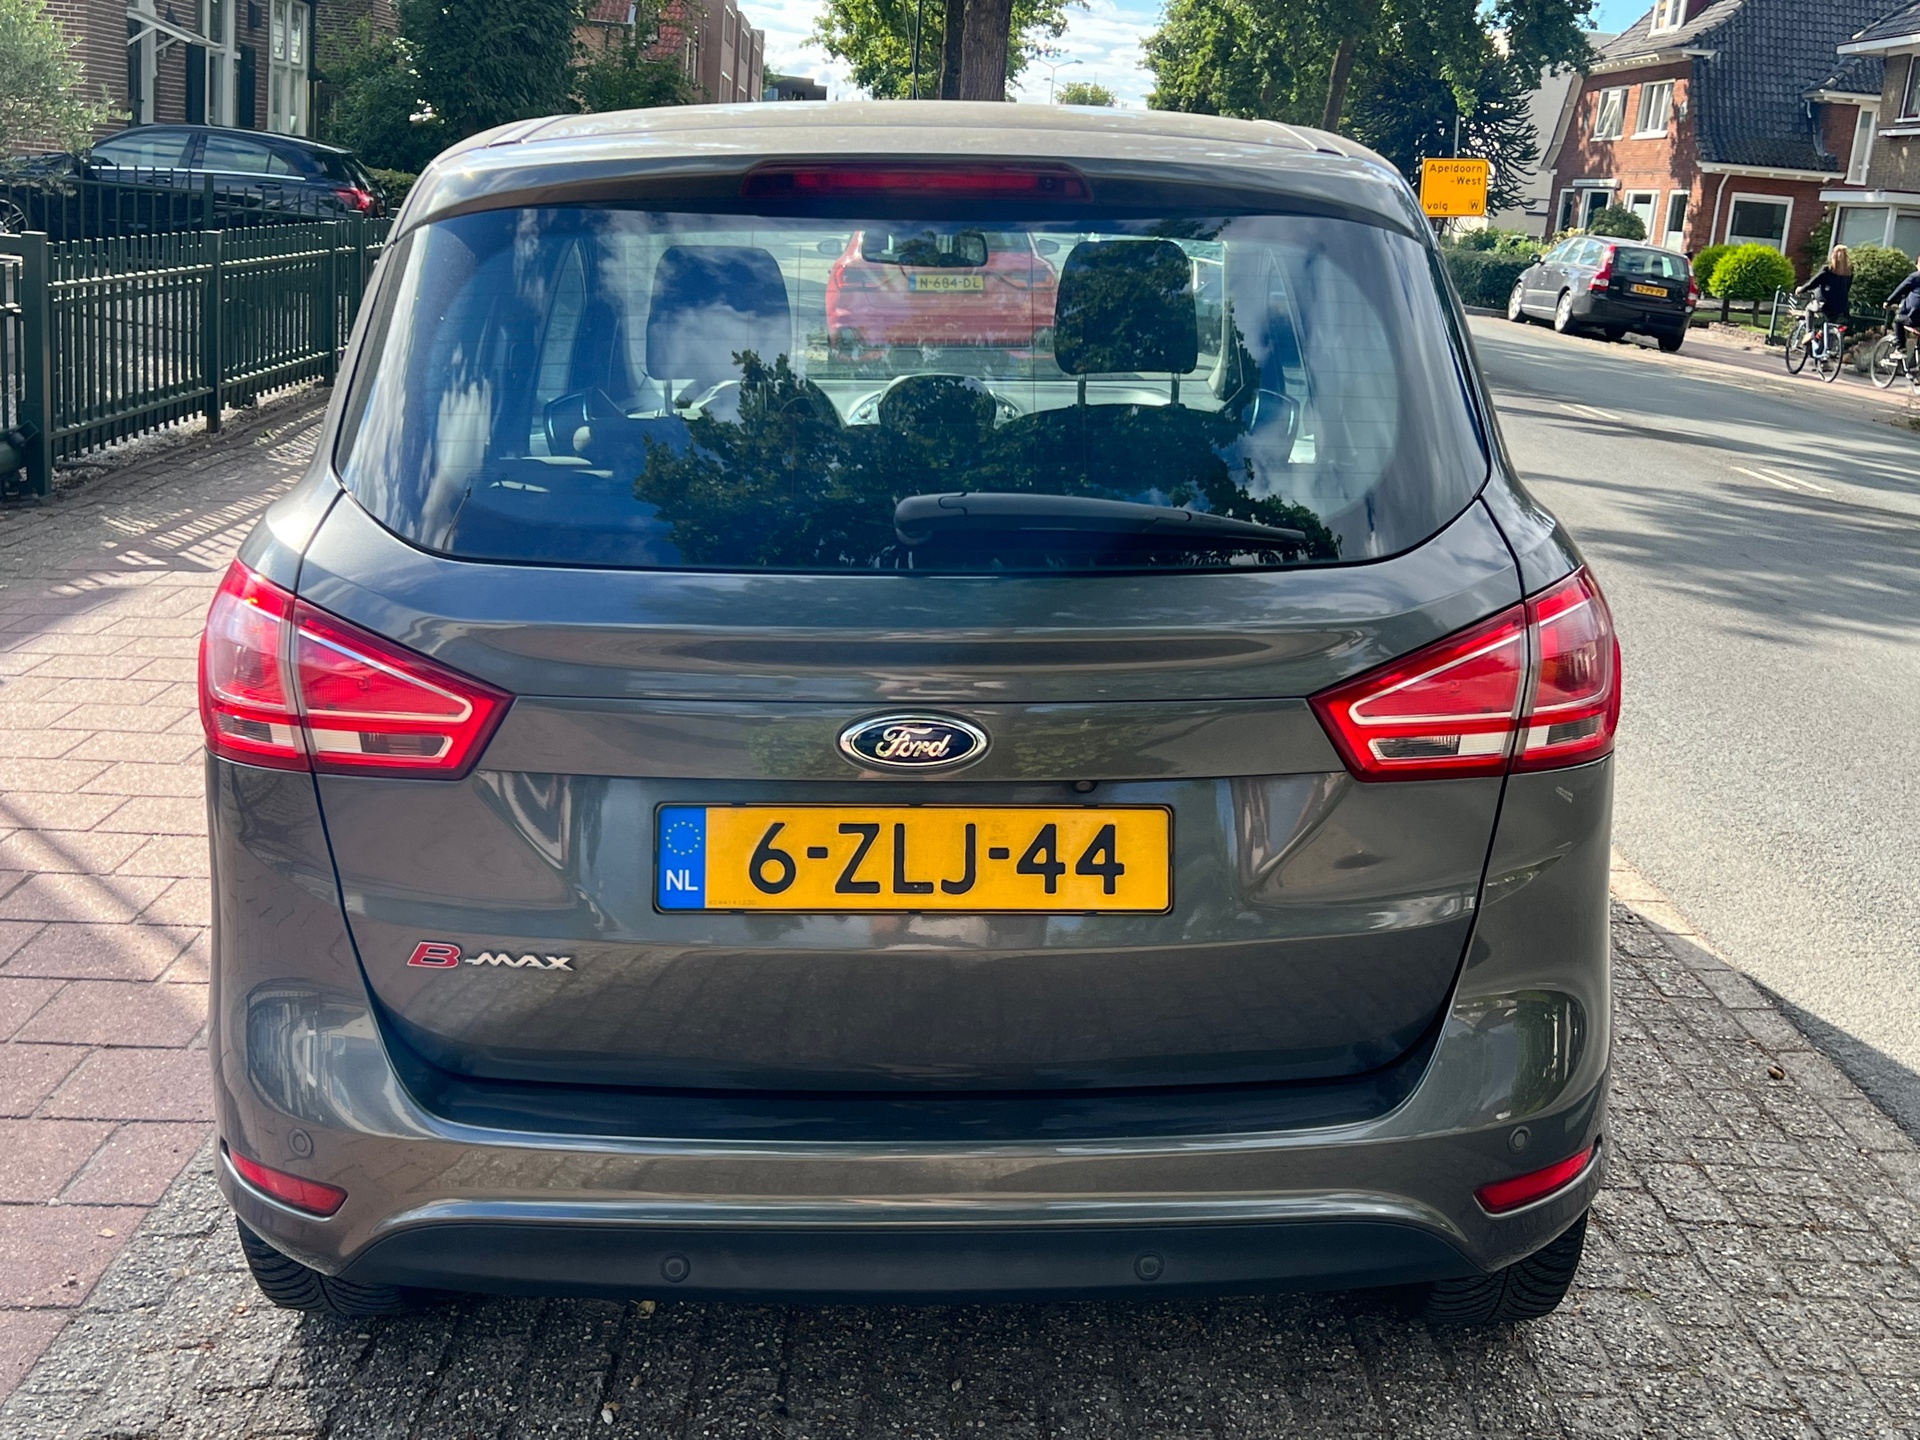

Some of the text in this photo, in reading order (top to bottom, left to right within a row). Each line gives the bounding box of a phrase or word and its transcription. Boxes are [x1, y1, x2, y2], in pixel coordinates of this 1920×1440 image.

[1429, 164, 1482, 173] Apeldoorn
[1450, 176, 1481, 185] -West
[1427, 201, 1479, 212] volg W
[920, 277, 980, 289] N-684-DL
[875, 726, 952, 758] Ford
[748, 822, 1125, 895] 6-ZLJ-44
[665, 869, 699, 891] NL
[407, 941, 575, 971] B-MAX
